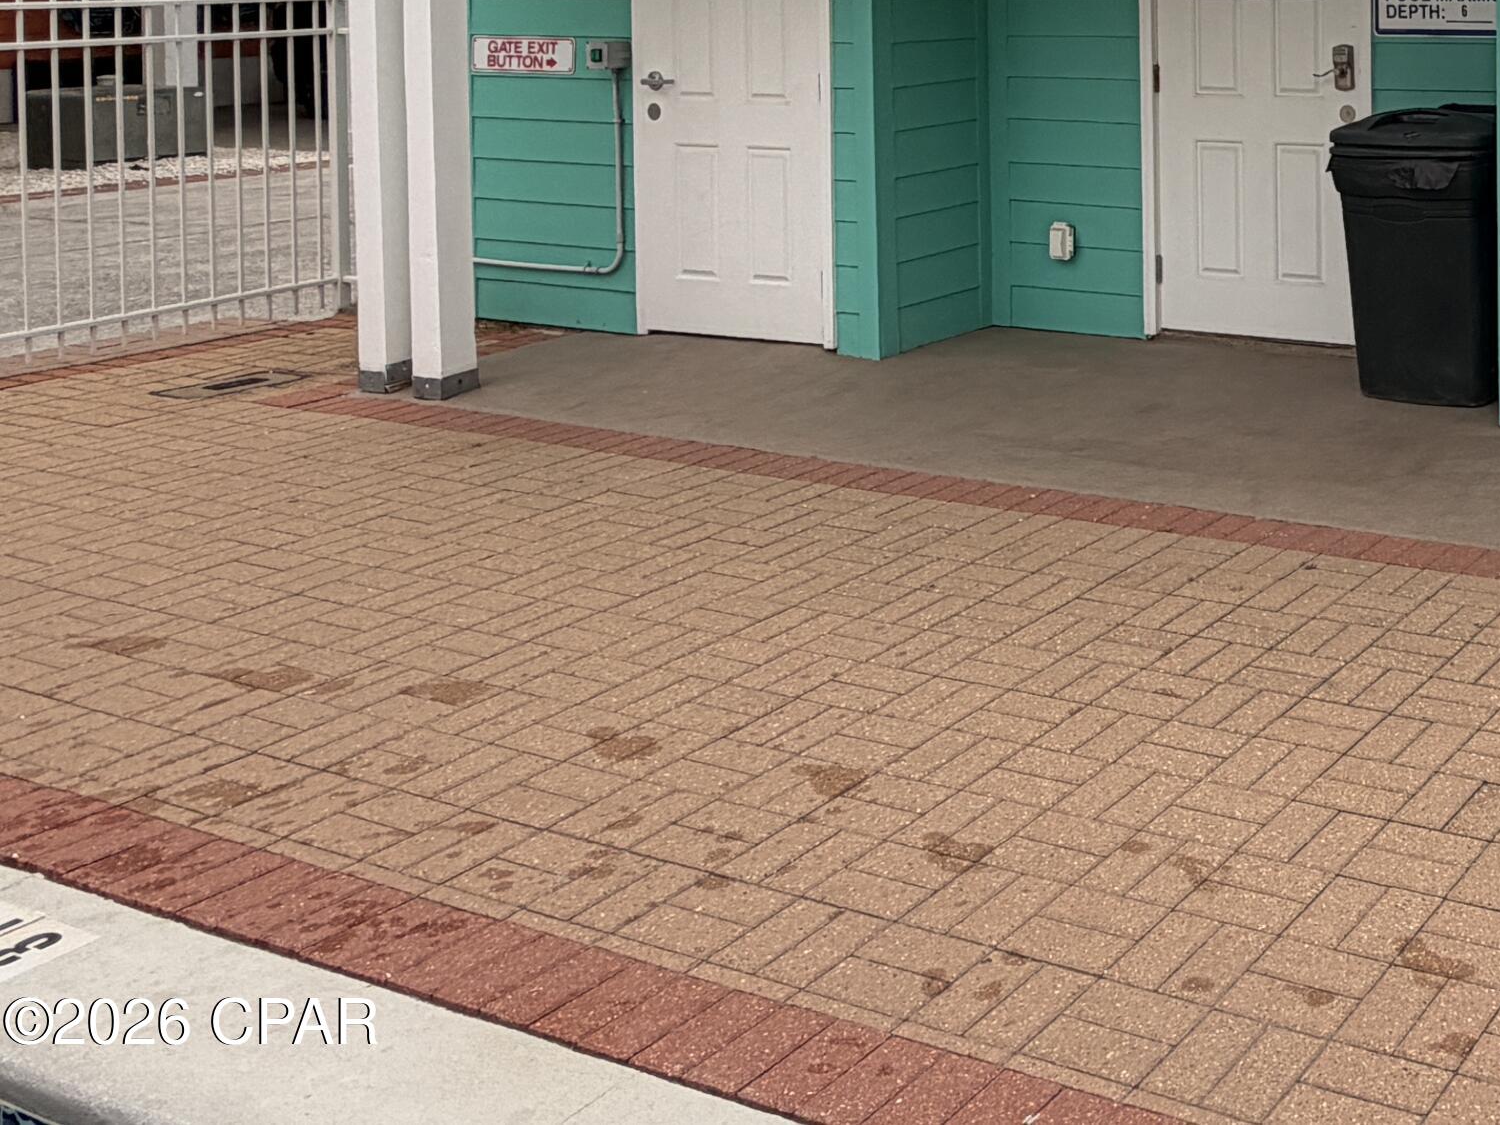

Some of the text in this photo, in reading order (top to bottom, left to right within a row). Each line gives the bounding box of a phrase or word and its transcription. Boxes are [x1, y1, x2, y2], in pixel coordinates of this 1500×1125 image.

[1386, 4, 1468, 20] DEPTH: 6
[488, 40, 558, 54] GATE EXIT
[487, 55, 543, 68] BUTTON
